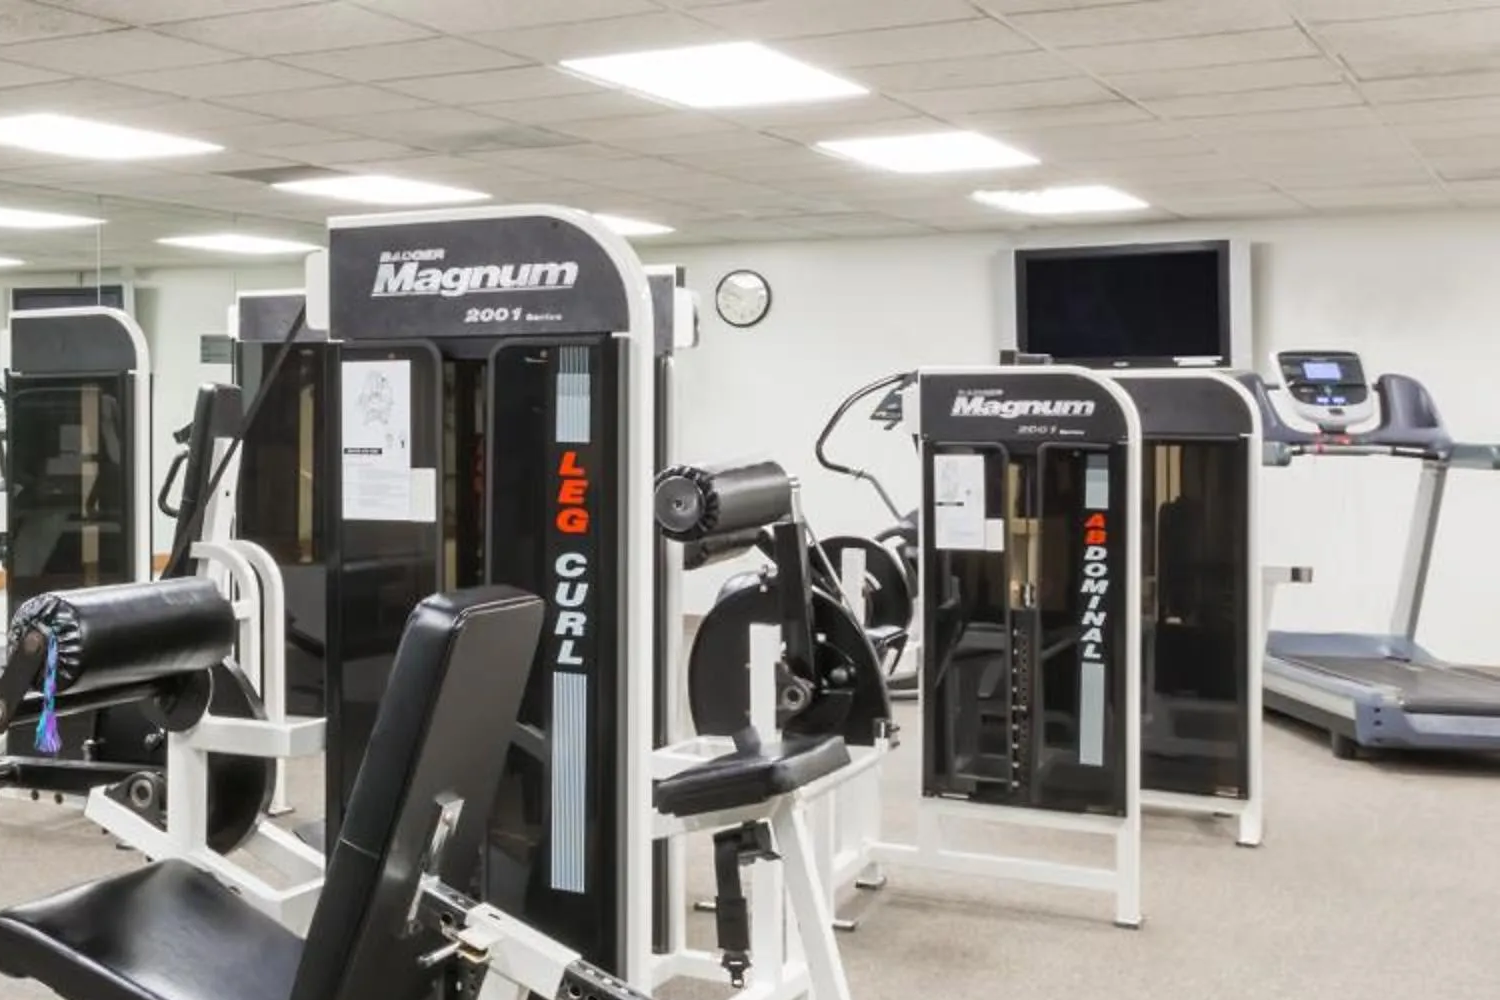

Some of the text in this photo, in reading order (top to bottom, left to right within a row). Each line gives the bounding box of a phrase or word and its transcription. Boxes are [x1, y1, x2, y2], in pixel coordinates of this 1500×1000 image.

[372, 261, 579, 297] Magnum
[464, 307, 523, 323] 2001
[950, 396, 1096, 419] Magnum
[554, 451, 590, 665] LEG CURL
[1080, 512, 1109, 660] ABDOMINAL
